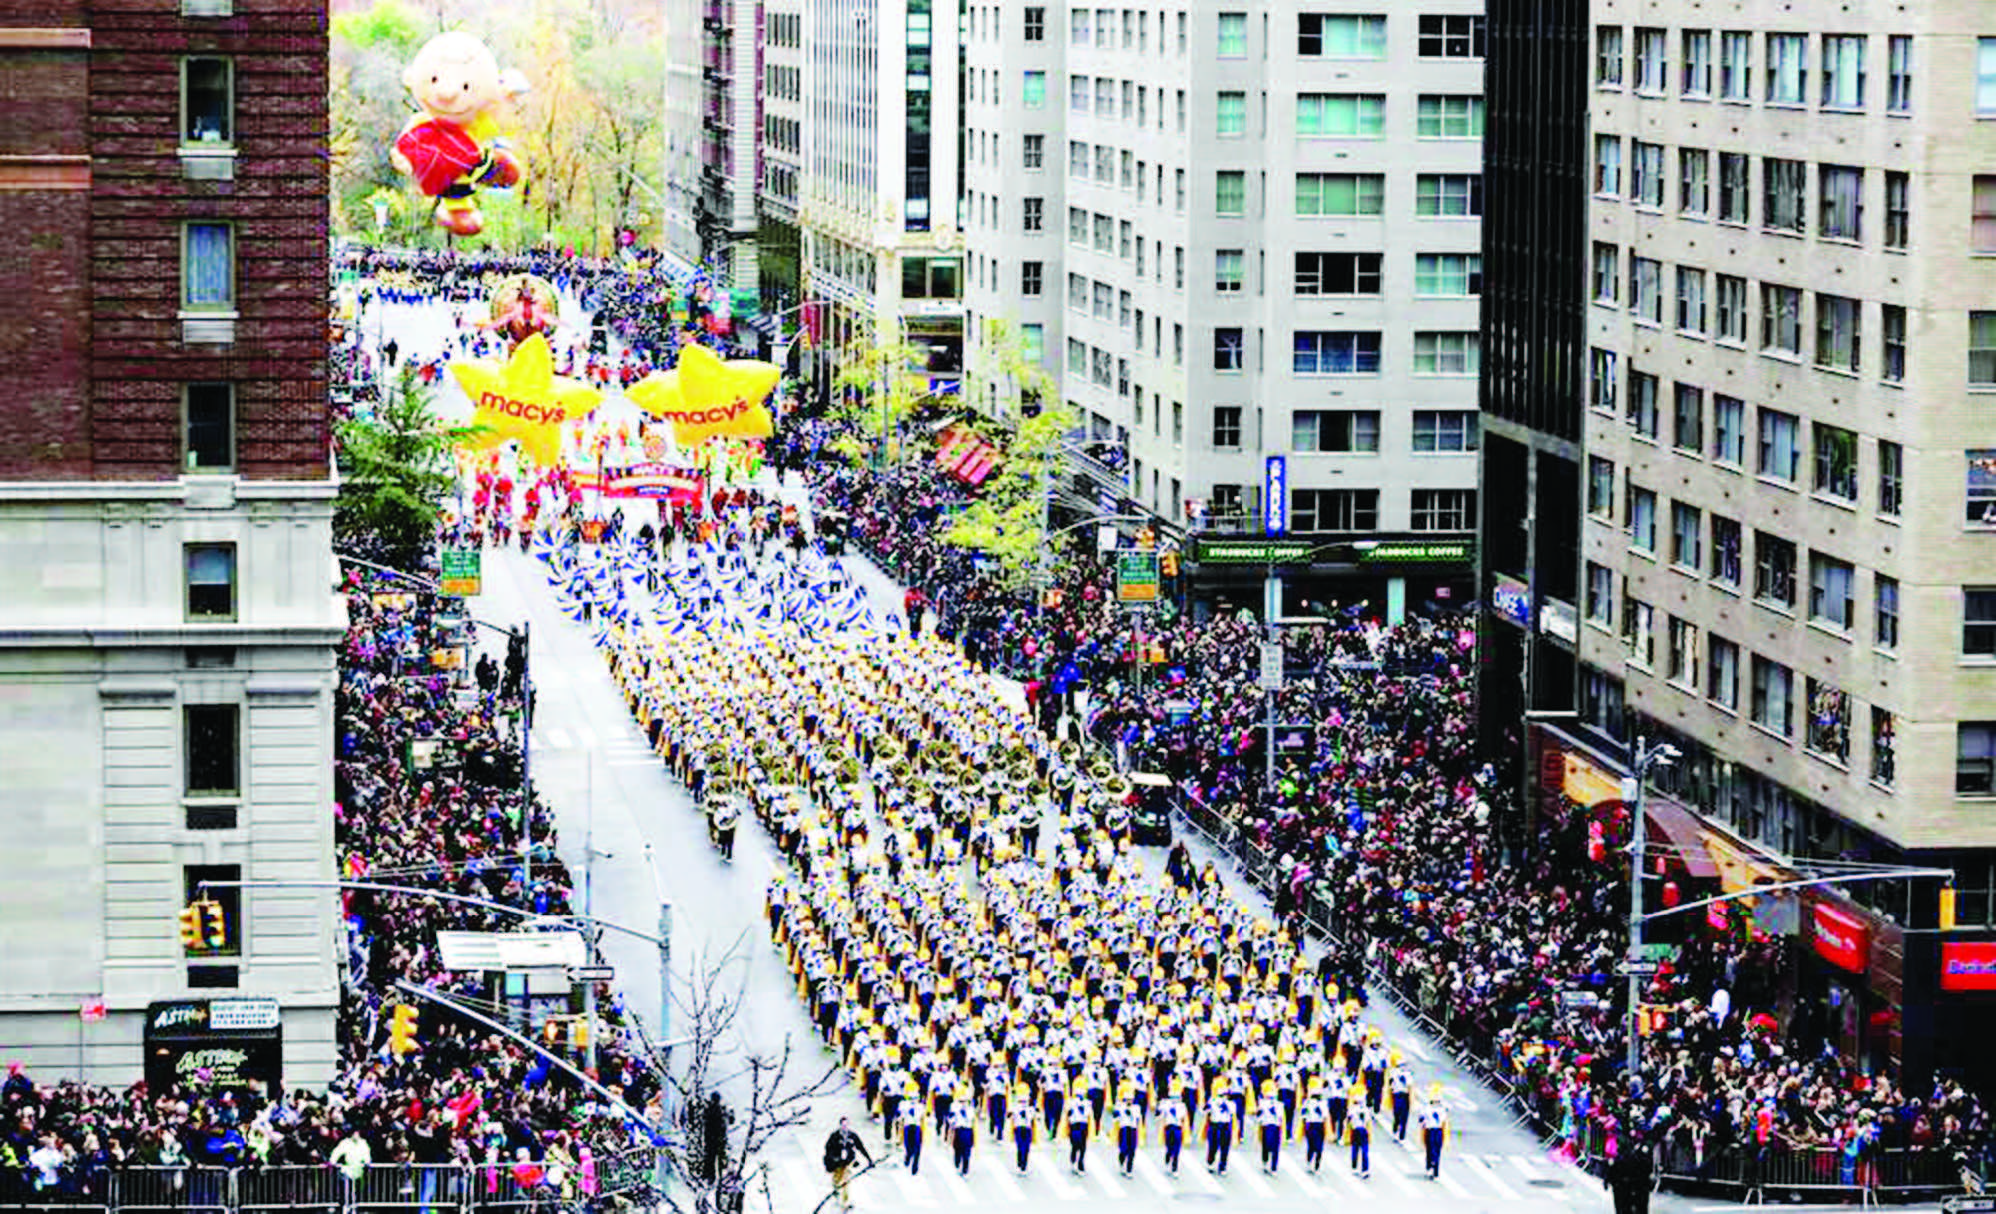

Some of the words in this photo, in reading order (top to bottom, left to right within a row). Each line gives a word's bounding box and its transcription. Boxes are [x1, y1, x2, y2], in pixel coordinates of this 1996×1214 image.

[480, 391, 566, 425] macy's
[1209, 547, 1266, 557] STARBUCKS
[1428, 546, 1463, 557] COFFEE
